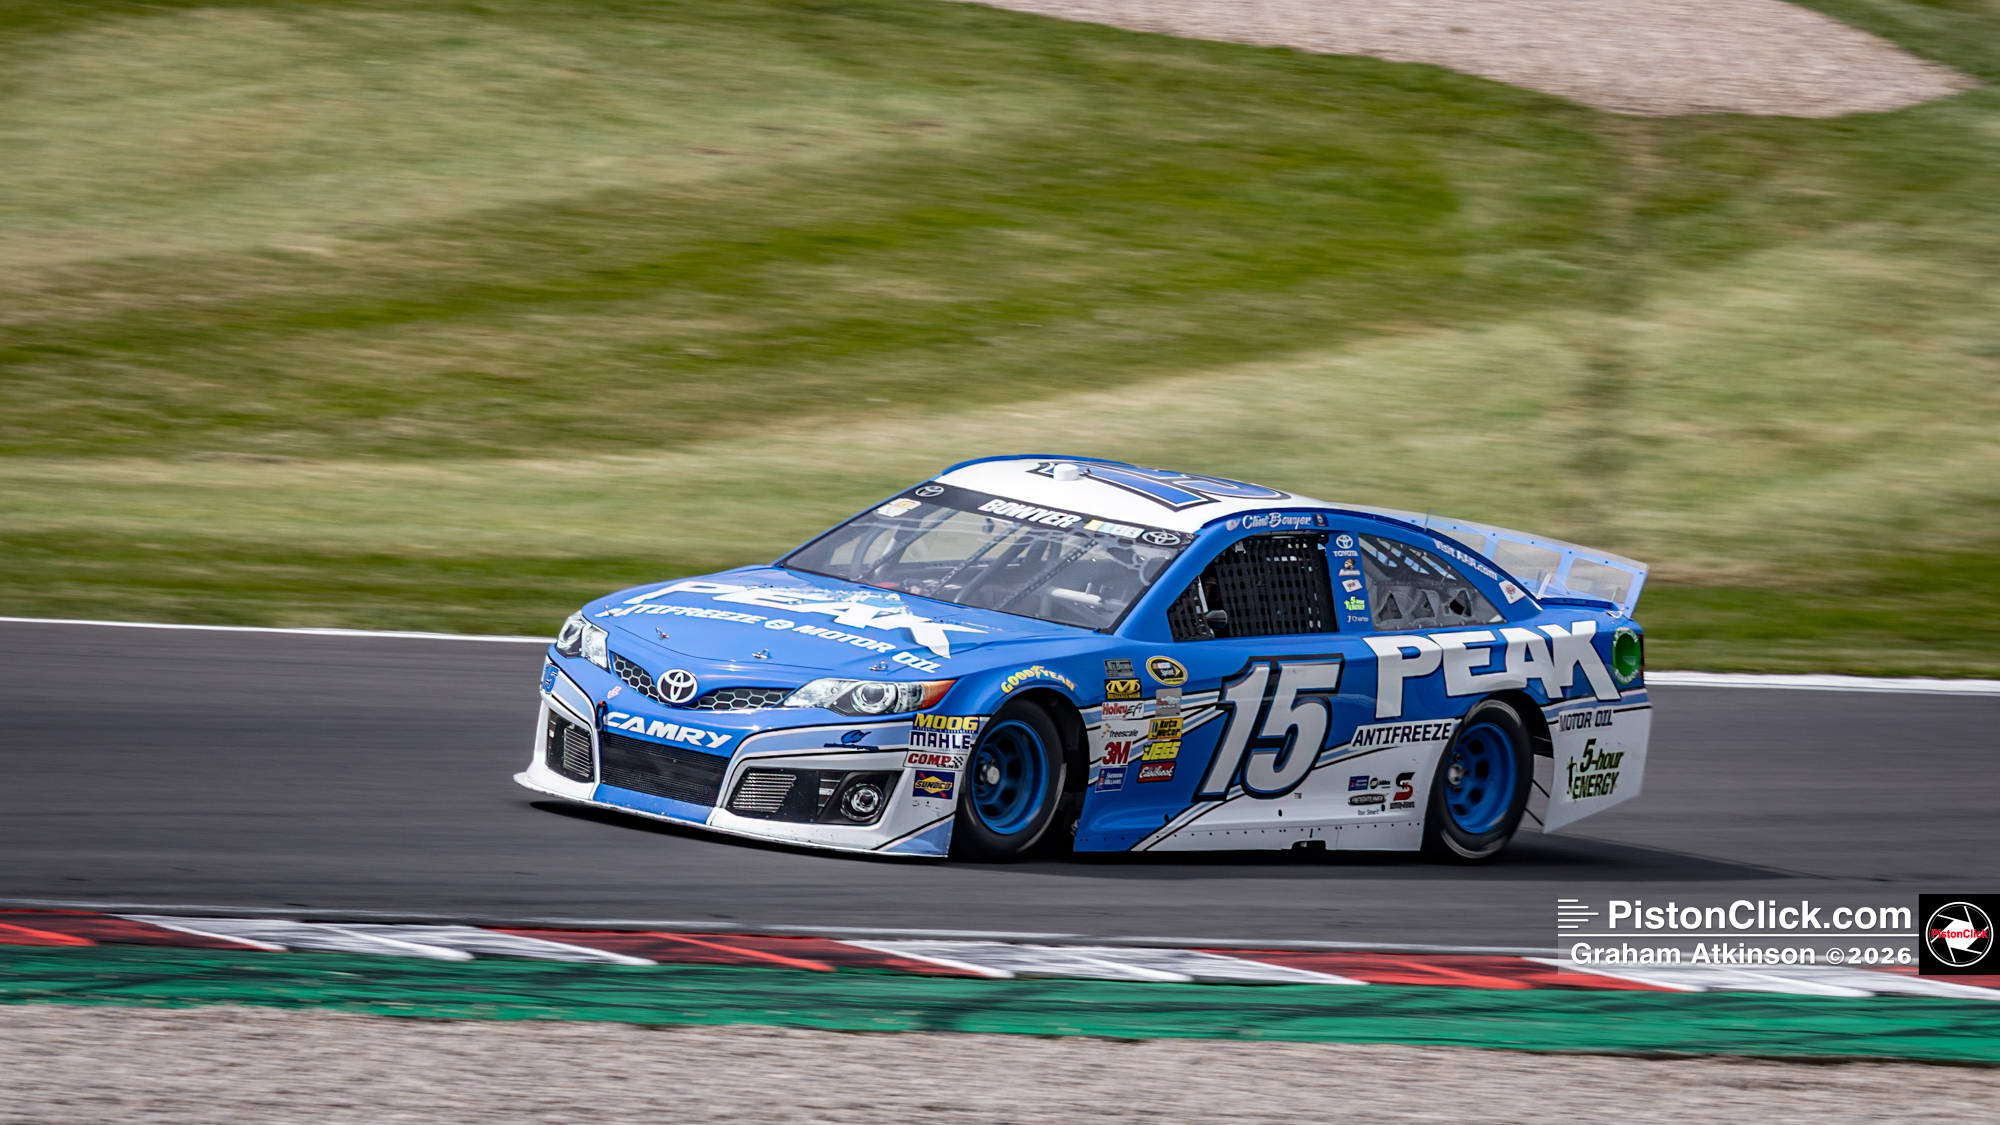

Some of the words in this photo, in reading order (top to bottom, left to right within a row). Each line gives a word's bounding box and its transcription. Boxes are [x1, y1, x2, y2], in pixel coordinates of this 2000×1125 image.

[977, 499, 1083, 528] BOWYER
[1242, 514, 1269, 530] Clint
[1268, 512, 1312, 530] Bowyer
[1333, 550, 1359, 558] TOYOTA
[622, 581, 990, 659] PEAK
[792, 624, 897, 653] MOTOR
[891, 651, 942, 674] OIL
[1001, 665, 1075, 694] GOODYEAR
[1363, 620, 1622, 719] PEAK
[1102, 702, 1129, 718] Holley
[1560, 711, 1592, 732] MOTOR
[1595, 709, 1613, 728] OIL
[603, 711, 733, 749] CAMRY
[914, 713, 979, 731] MOOG
[1109, 729, 1139, 738] freescale
[1159, 719, 1178, 729] Auto
[1193, 654, 1345, 802] 15
[910, 731, 971, 750] MAHLE
[1351, 722, 1452, 748] ANTIFREEZE
[907, 753, 952, 767] COMP
[1103, 741, 1131, 765] 3M
[1141, 741, 1182, 761] JEGS
[1580, 738, 1625, 773] 5-hour
[917, 780, 952, 790] SUNOCO
[1572, 771, 1620, 800] ENERGY
